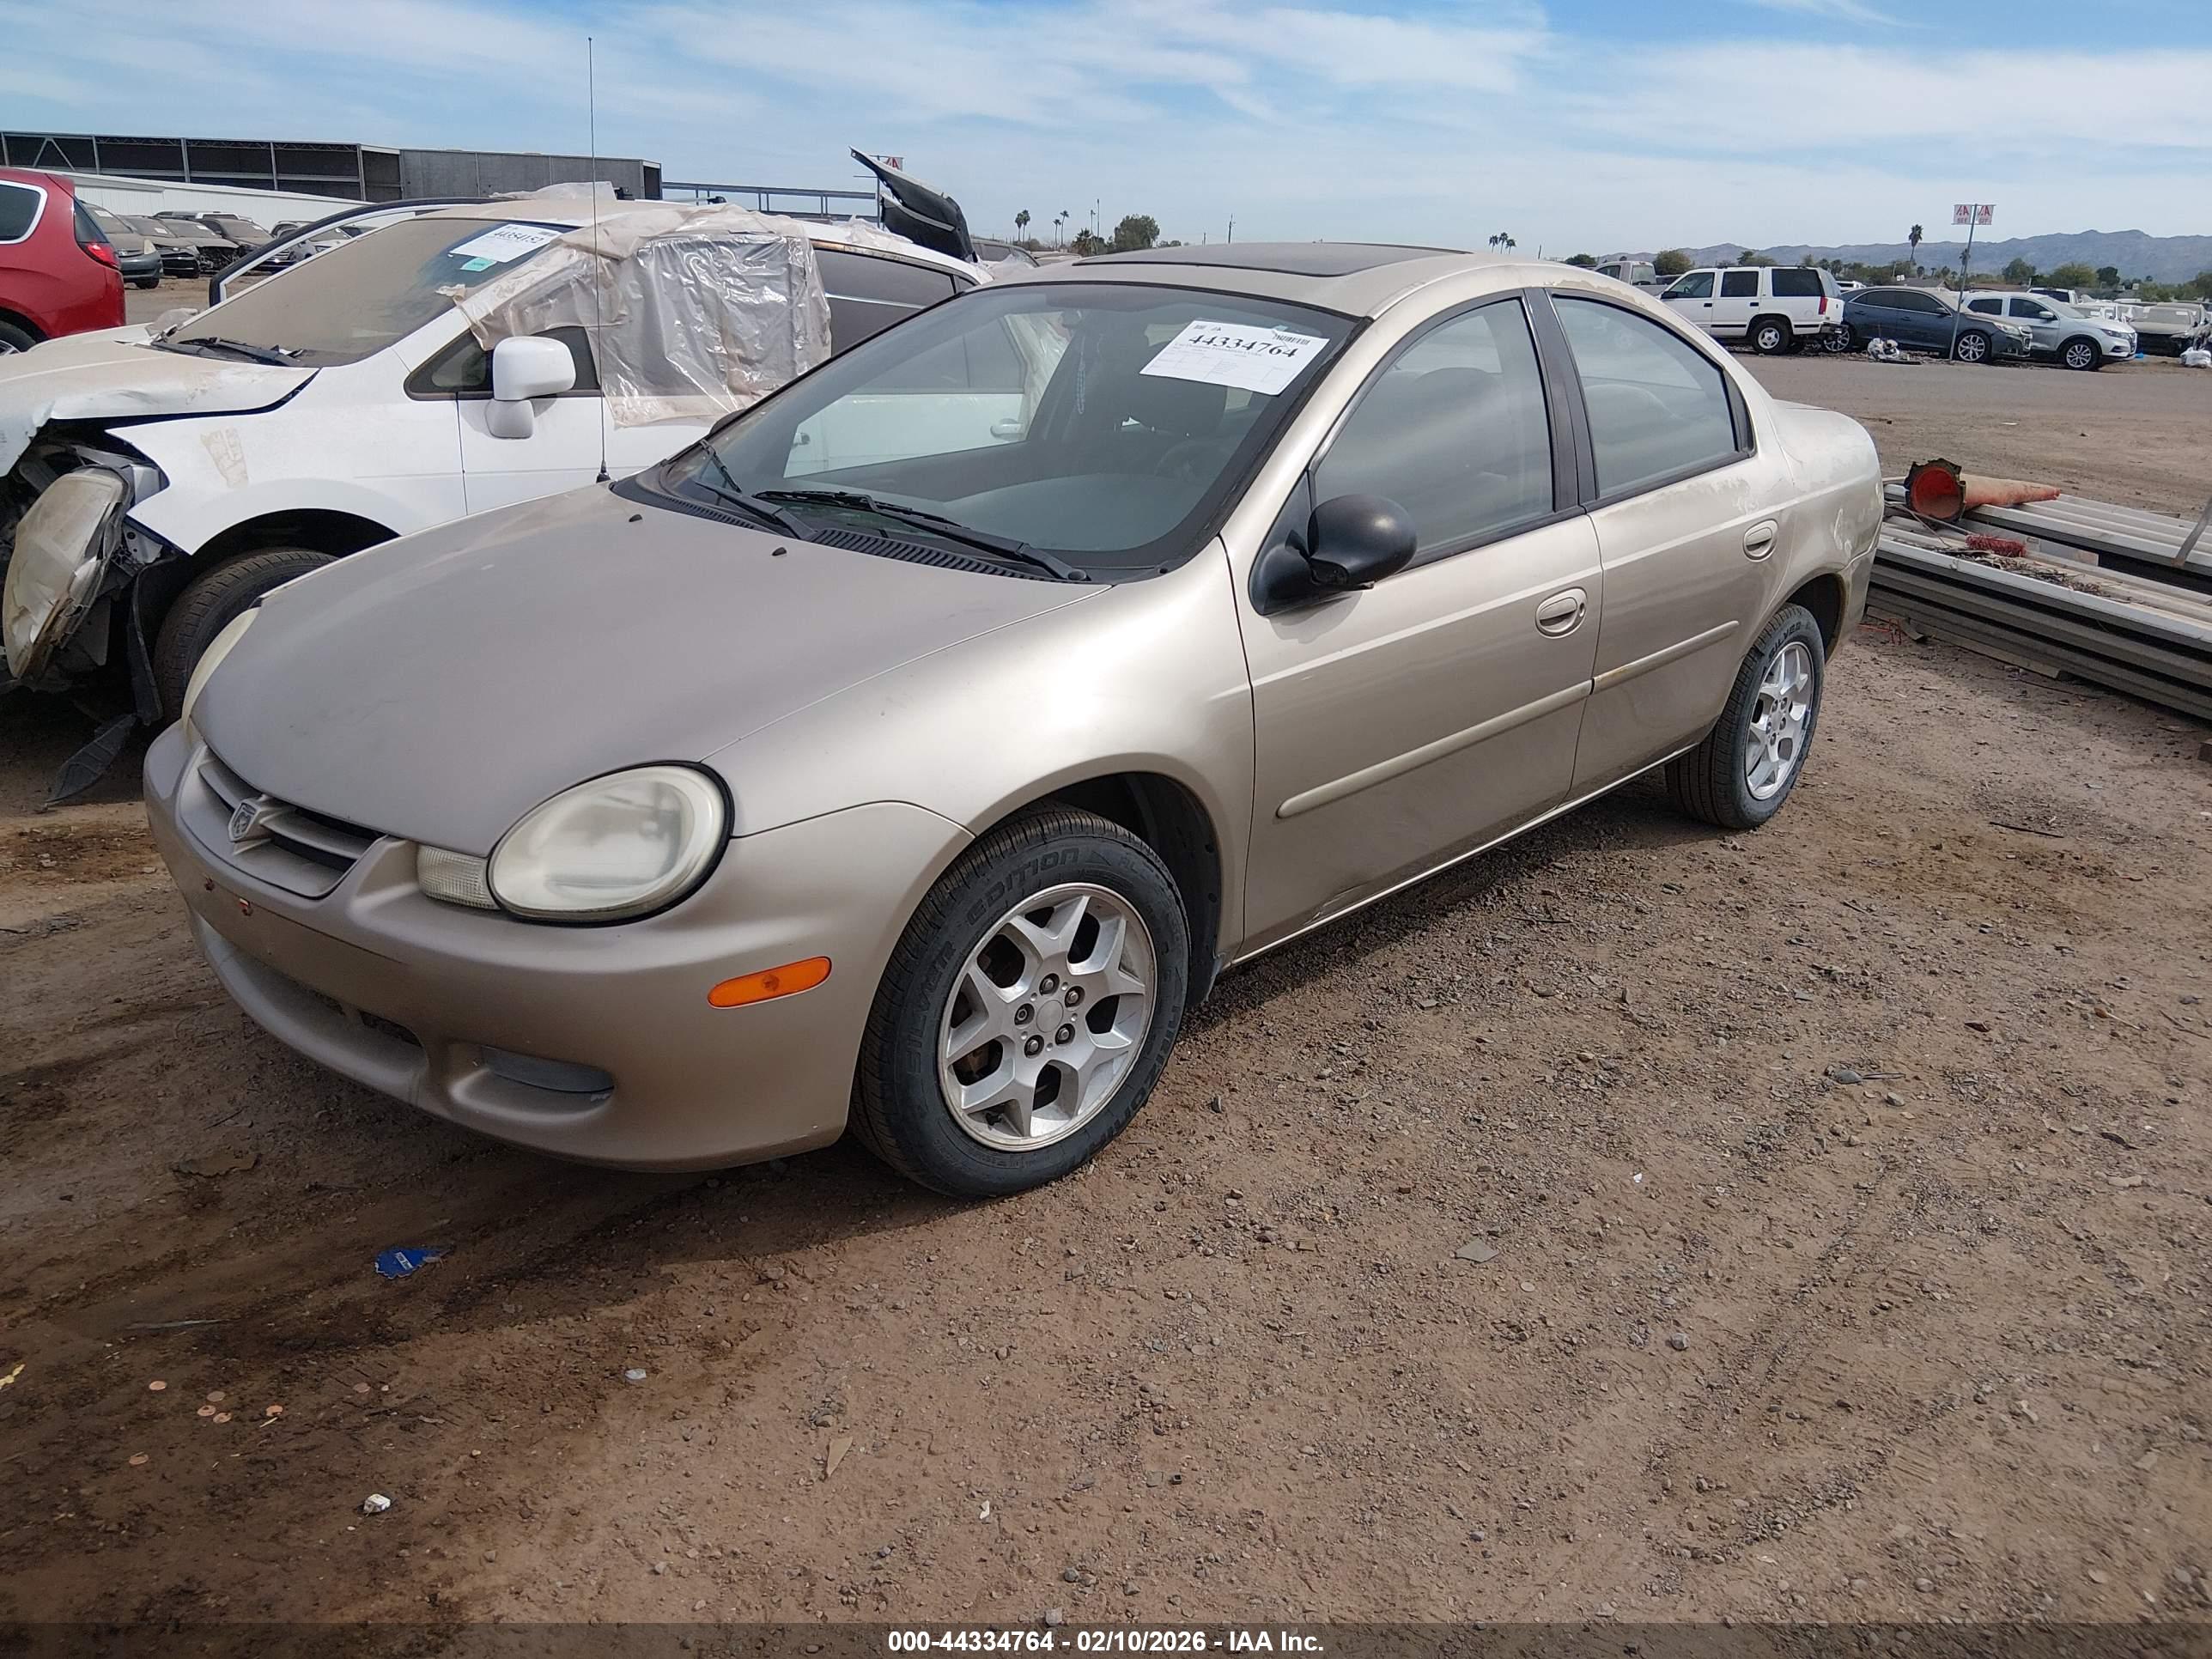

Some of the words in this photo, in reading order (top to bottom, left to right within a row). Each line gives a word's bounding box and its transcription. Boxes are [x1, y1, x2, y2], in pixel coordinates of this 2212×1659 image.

[1188, 333, 1299, 358] 44334764
[905, 939, 956, 1077] SILVER
[966, 848, 1079, 924] EDITION
